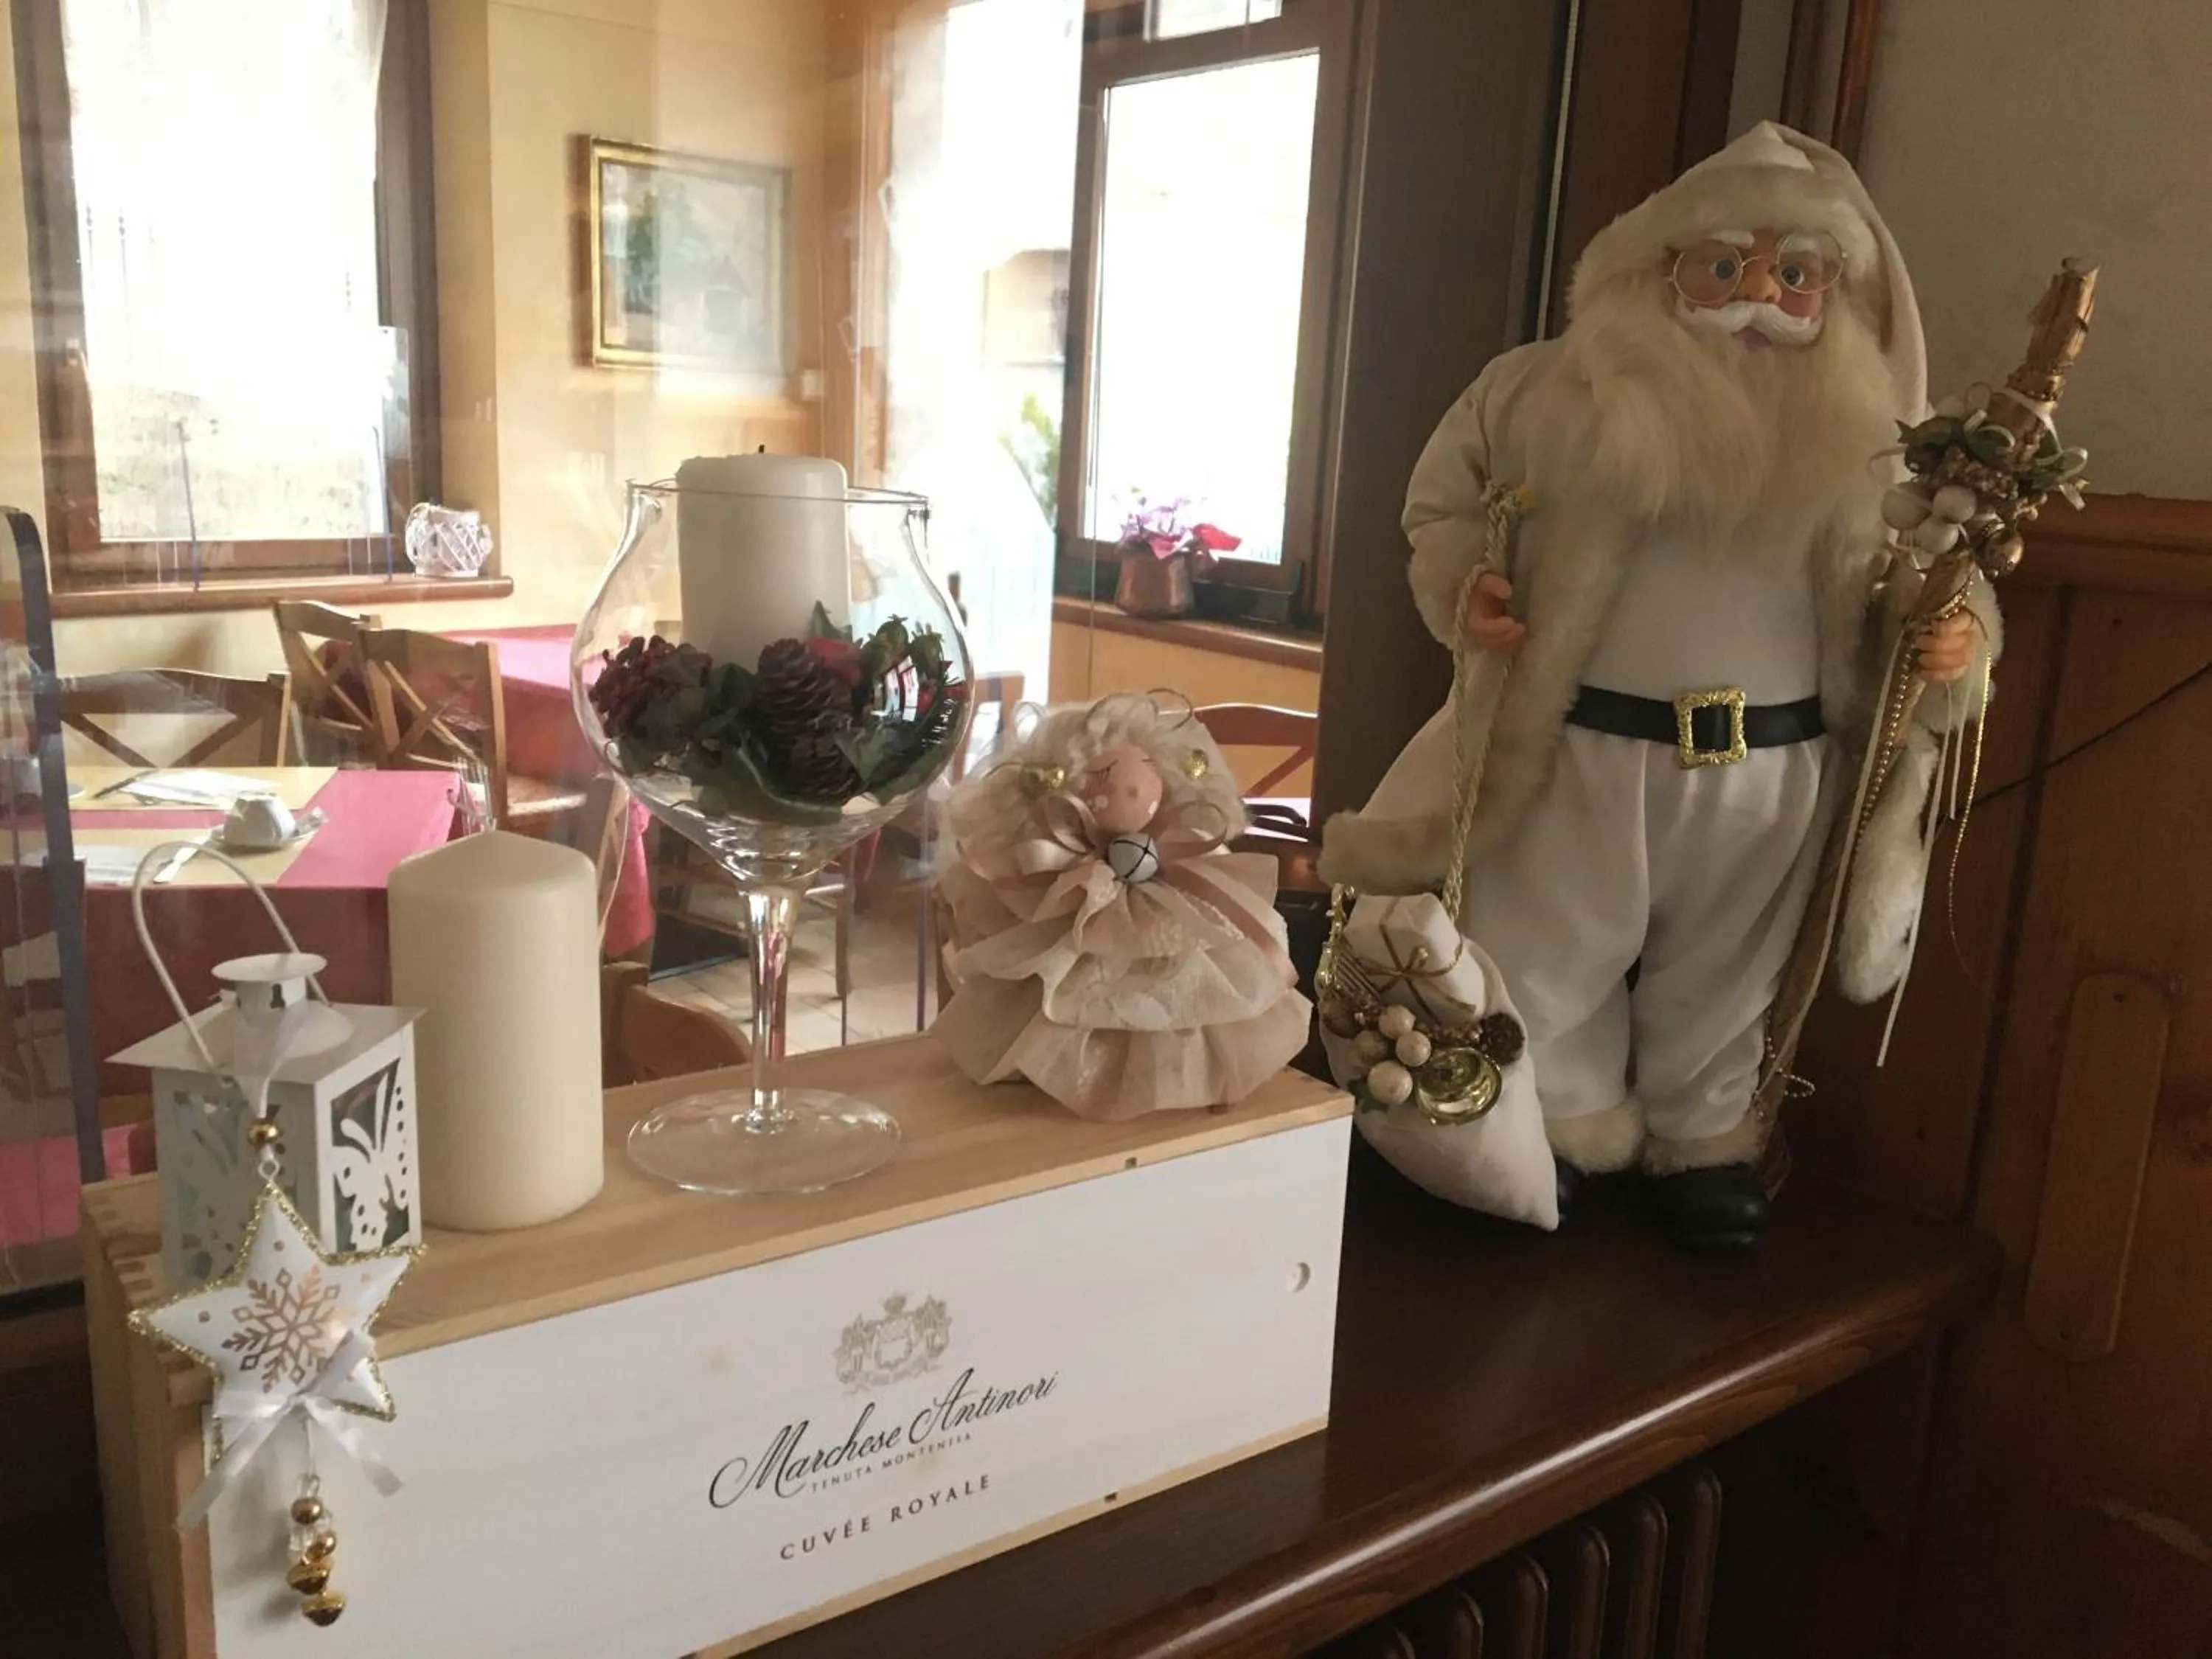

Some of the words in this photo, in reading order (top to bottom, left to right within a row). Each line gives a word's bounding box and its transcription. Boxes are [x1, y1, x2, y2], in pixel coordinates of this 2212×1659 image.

[709, 1402, 902, 1509] Marchese
[908, 1367, 1060, 1445] Antinori
[812, 1465, 872, 1493] TENUTA
[779, 1520, 872, 1561] CUVÉE
[890, 1474, 990, 1523] ROYALE
